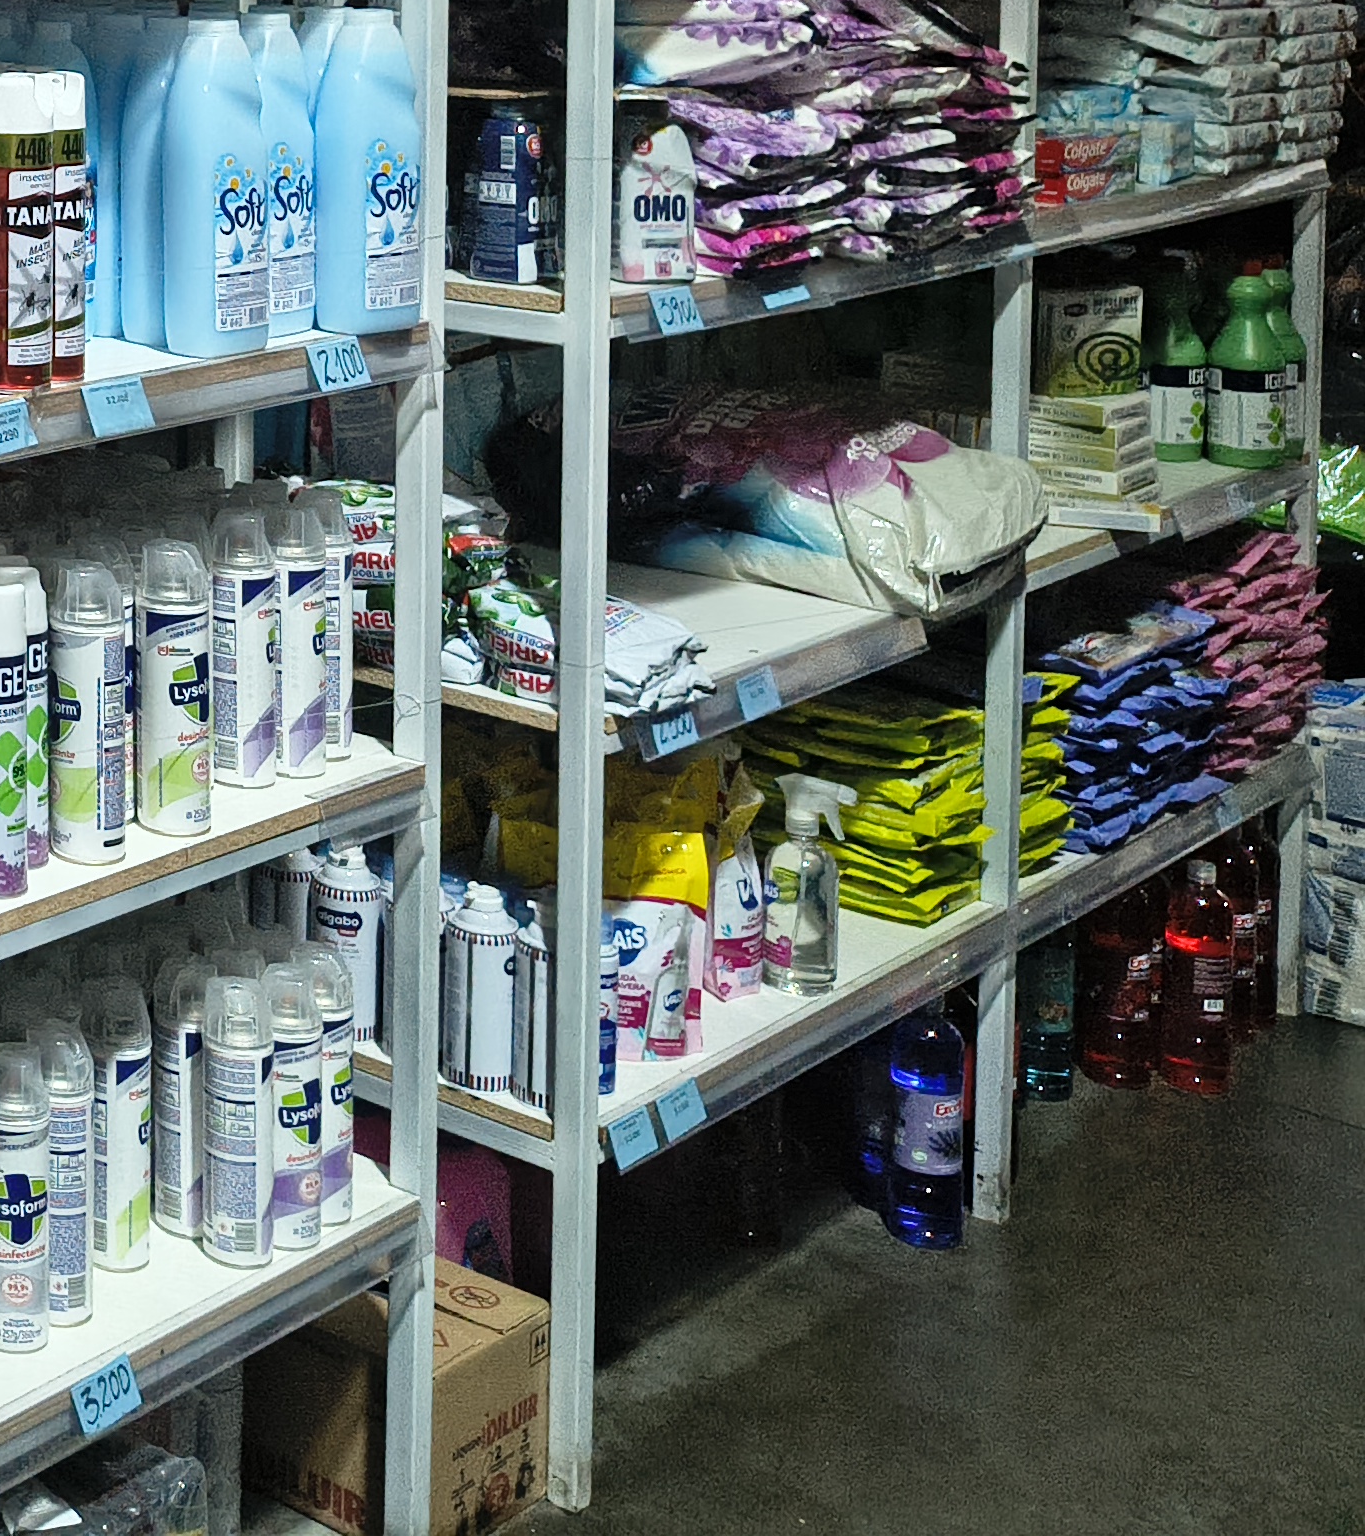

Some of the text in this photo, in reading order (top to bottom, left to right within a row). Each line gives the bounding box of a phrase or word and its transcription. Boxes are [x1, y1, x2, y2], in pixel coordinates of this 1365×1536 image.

[220, 187, 266, 236] Soft
[371, 171, 418, 219] Soft
[633, 193, 686, 222] OMO
